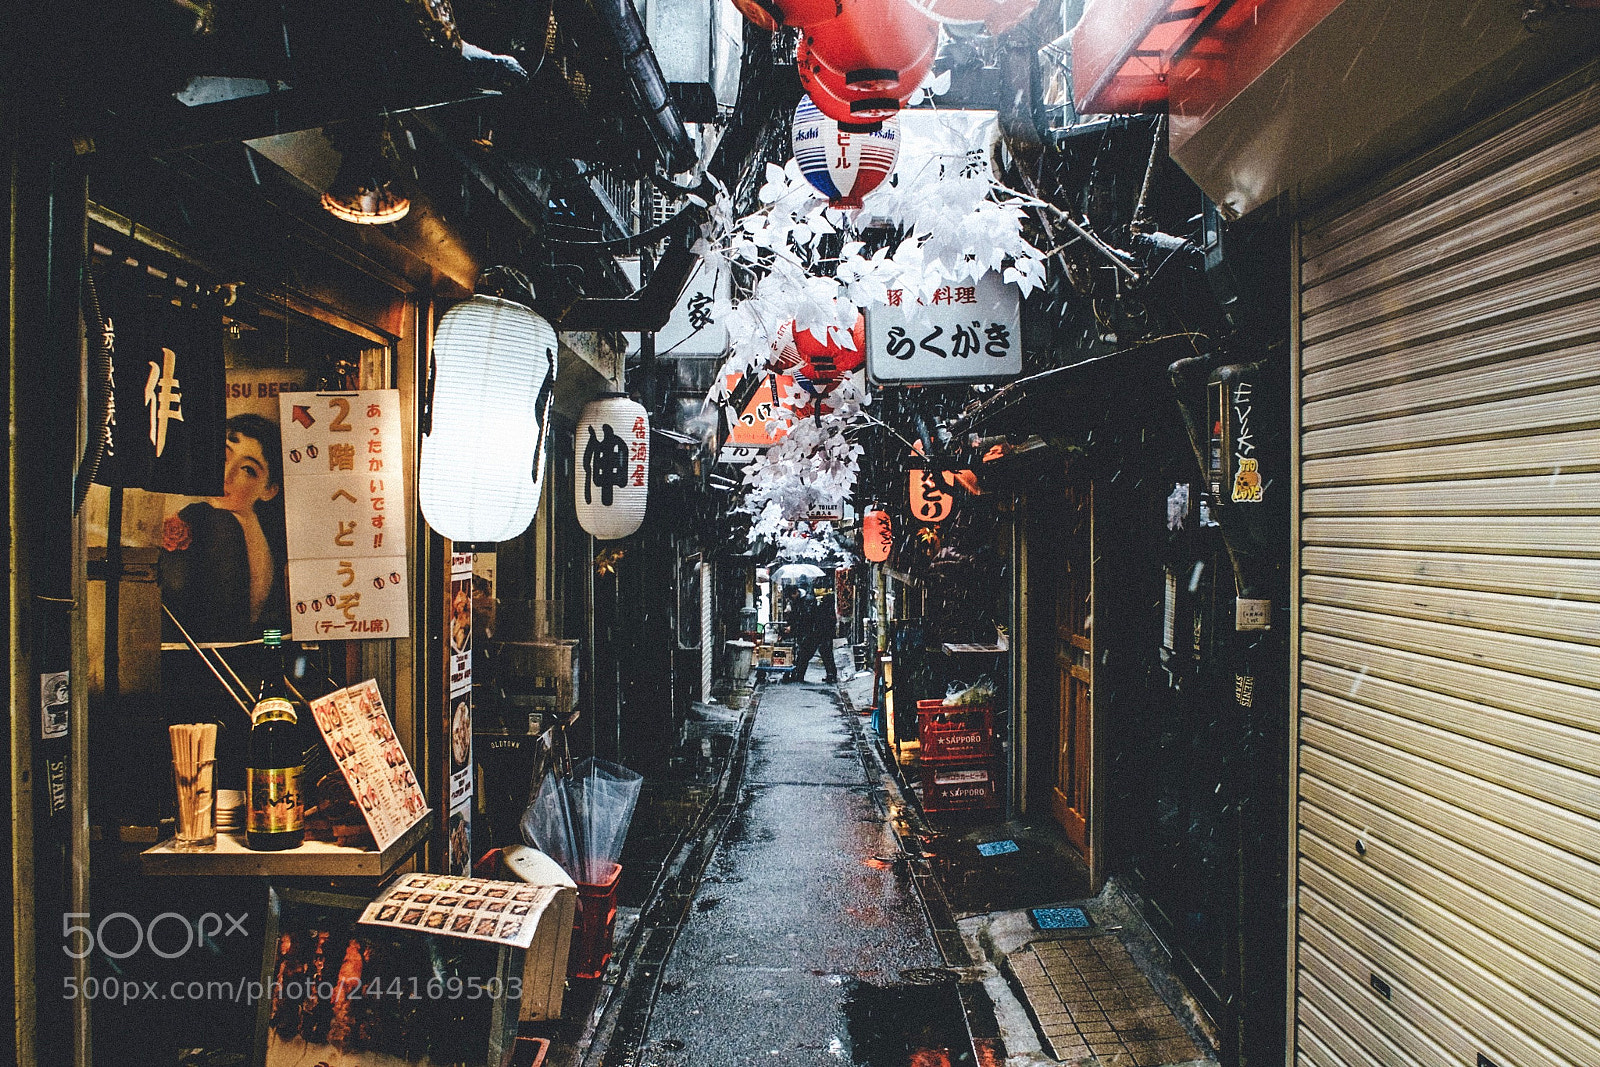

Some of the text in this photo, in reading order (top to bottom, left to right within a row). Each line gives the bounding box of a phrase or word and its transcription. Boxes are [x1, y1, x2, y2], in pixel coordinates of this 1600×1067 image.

[887, 286, 977, 306] 豚料理
[886, 320, 1011, 360] らくがき
[630, 416, 647, 487] 居酒屋
[328, 398, 361, 620] 2階へどうぞ
[946, 735, 981, 744] SAPPORO
[949, 788, 985, 797] SAPPORO
